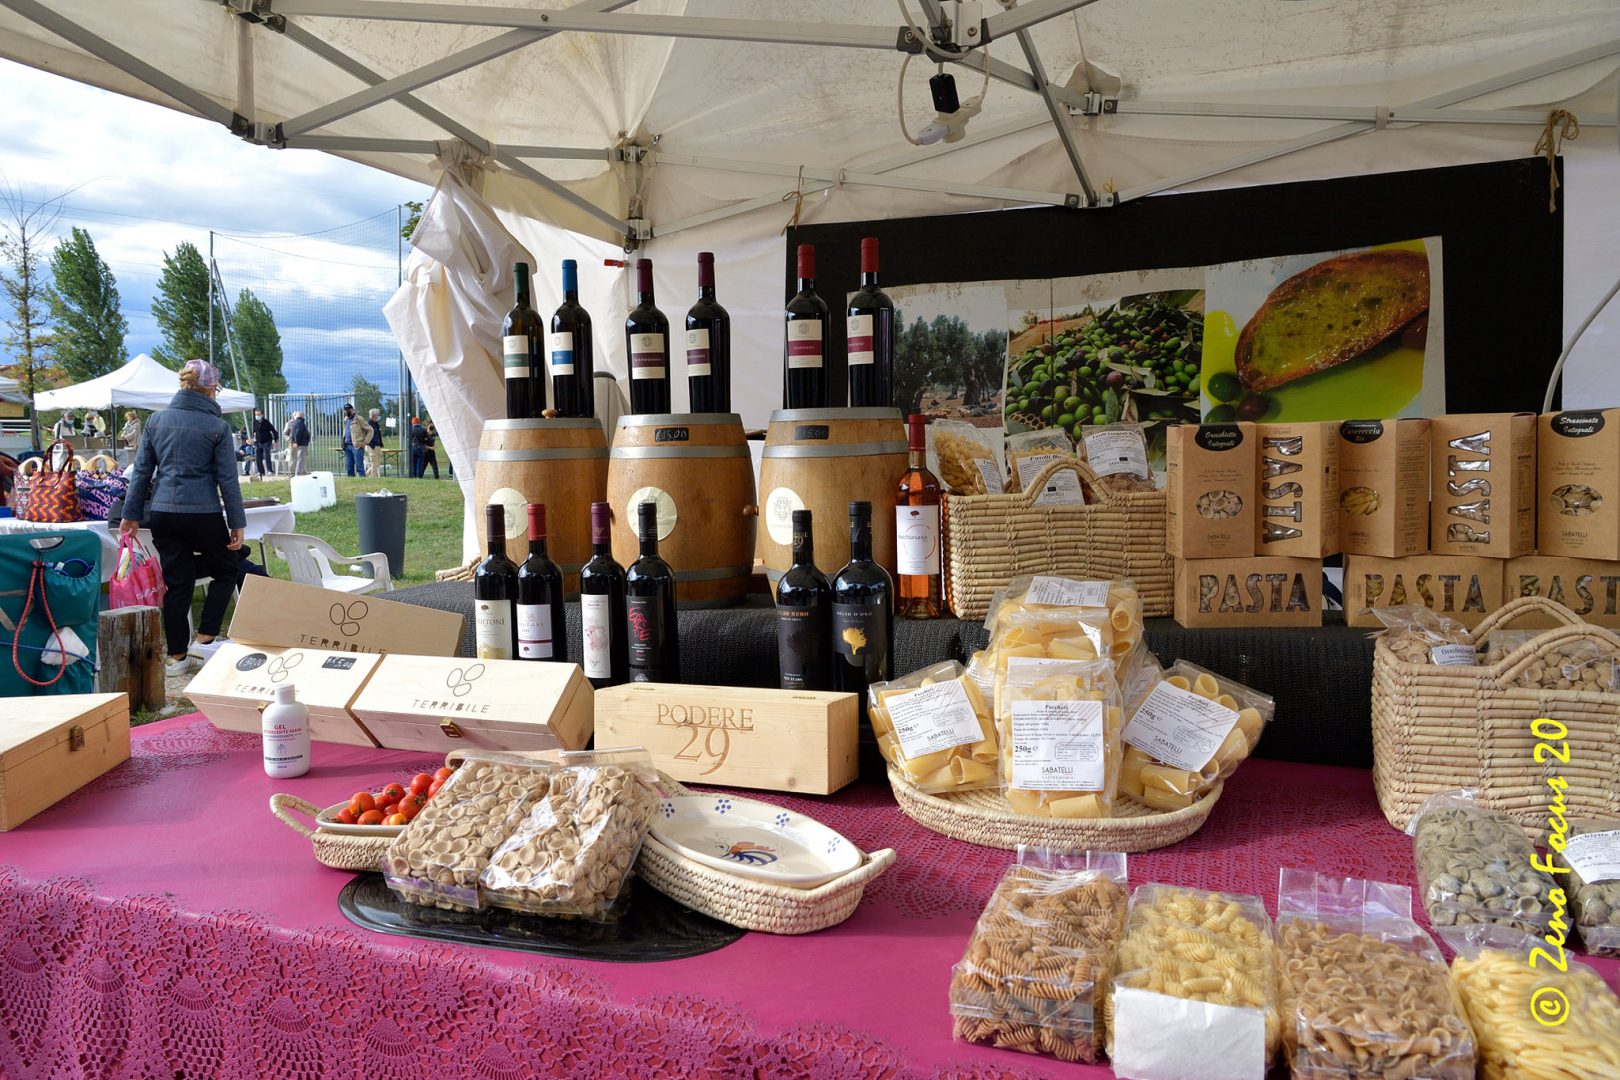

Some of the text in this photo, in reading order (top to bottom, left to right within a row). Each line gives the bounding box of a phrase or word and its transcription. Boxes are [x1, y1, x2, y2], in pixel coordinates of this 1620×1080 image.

[1559, 416, 1599, 424] Strascinate
[1563, 425, 1595, 435] Integrali
[1207, 440, 1235, 449] Integrali
[1262, 435, 1303, 544] PASTA
[1447, 430, 1491, 544] PASTA
[1199, 573, 1311, 614] PASTA
[1364, 573, 1487, 613] PASTA
[300, 633, 387, 654] TERRIBILE
[412, 699, 491, 714] TERRIBILE
[656, 703, 754, 731] PODERE
[927, 728, 955, 741] SABATELLI
[674, 723, 730, 776] 29
[1014, 745, 1032, 754] 250g
[1153, 735, 1183, 754] SABATELLI
[1041, 766, 1074, 774] SABATELLI
